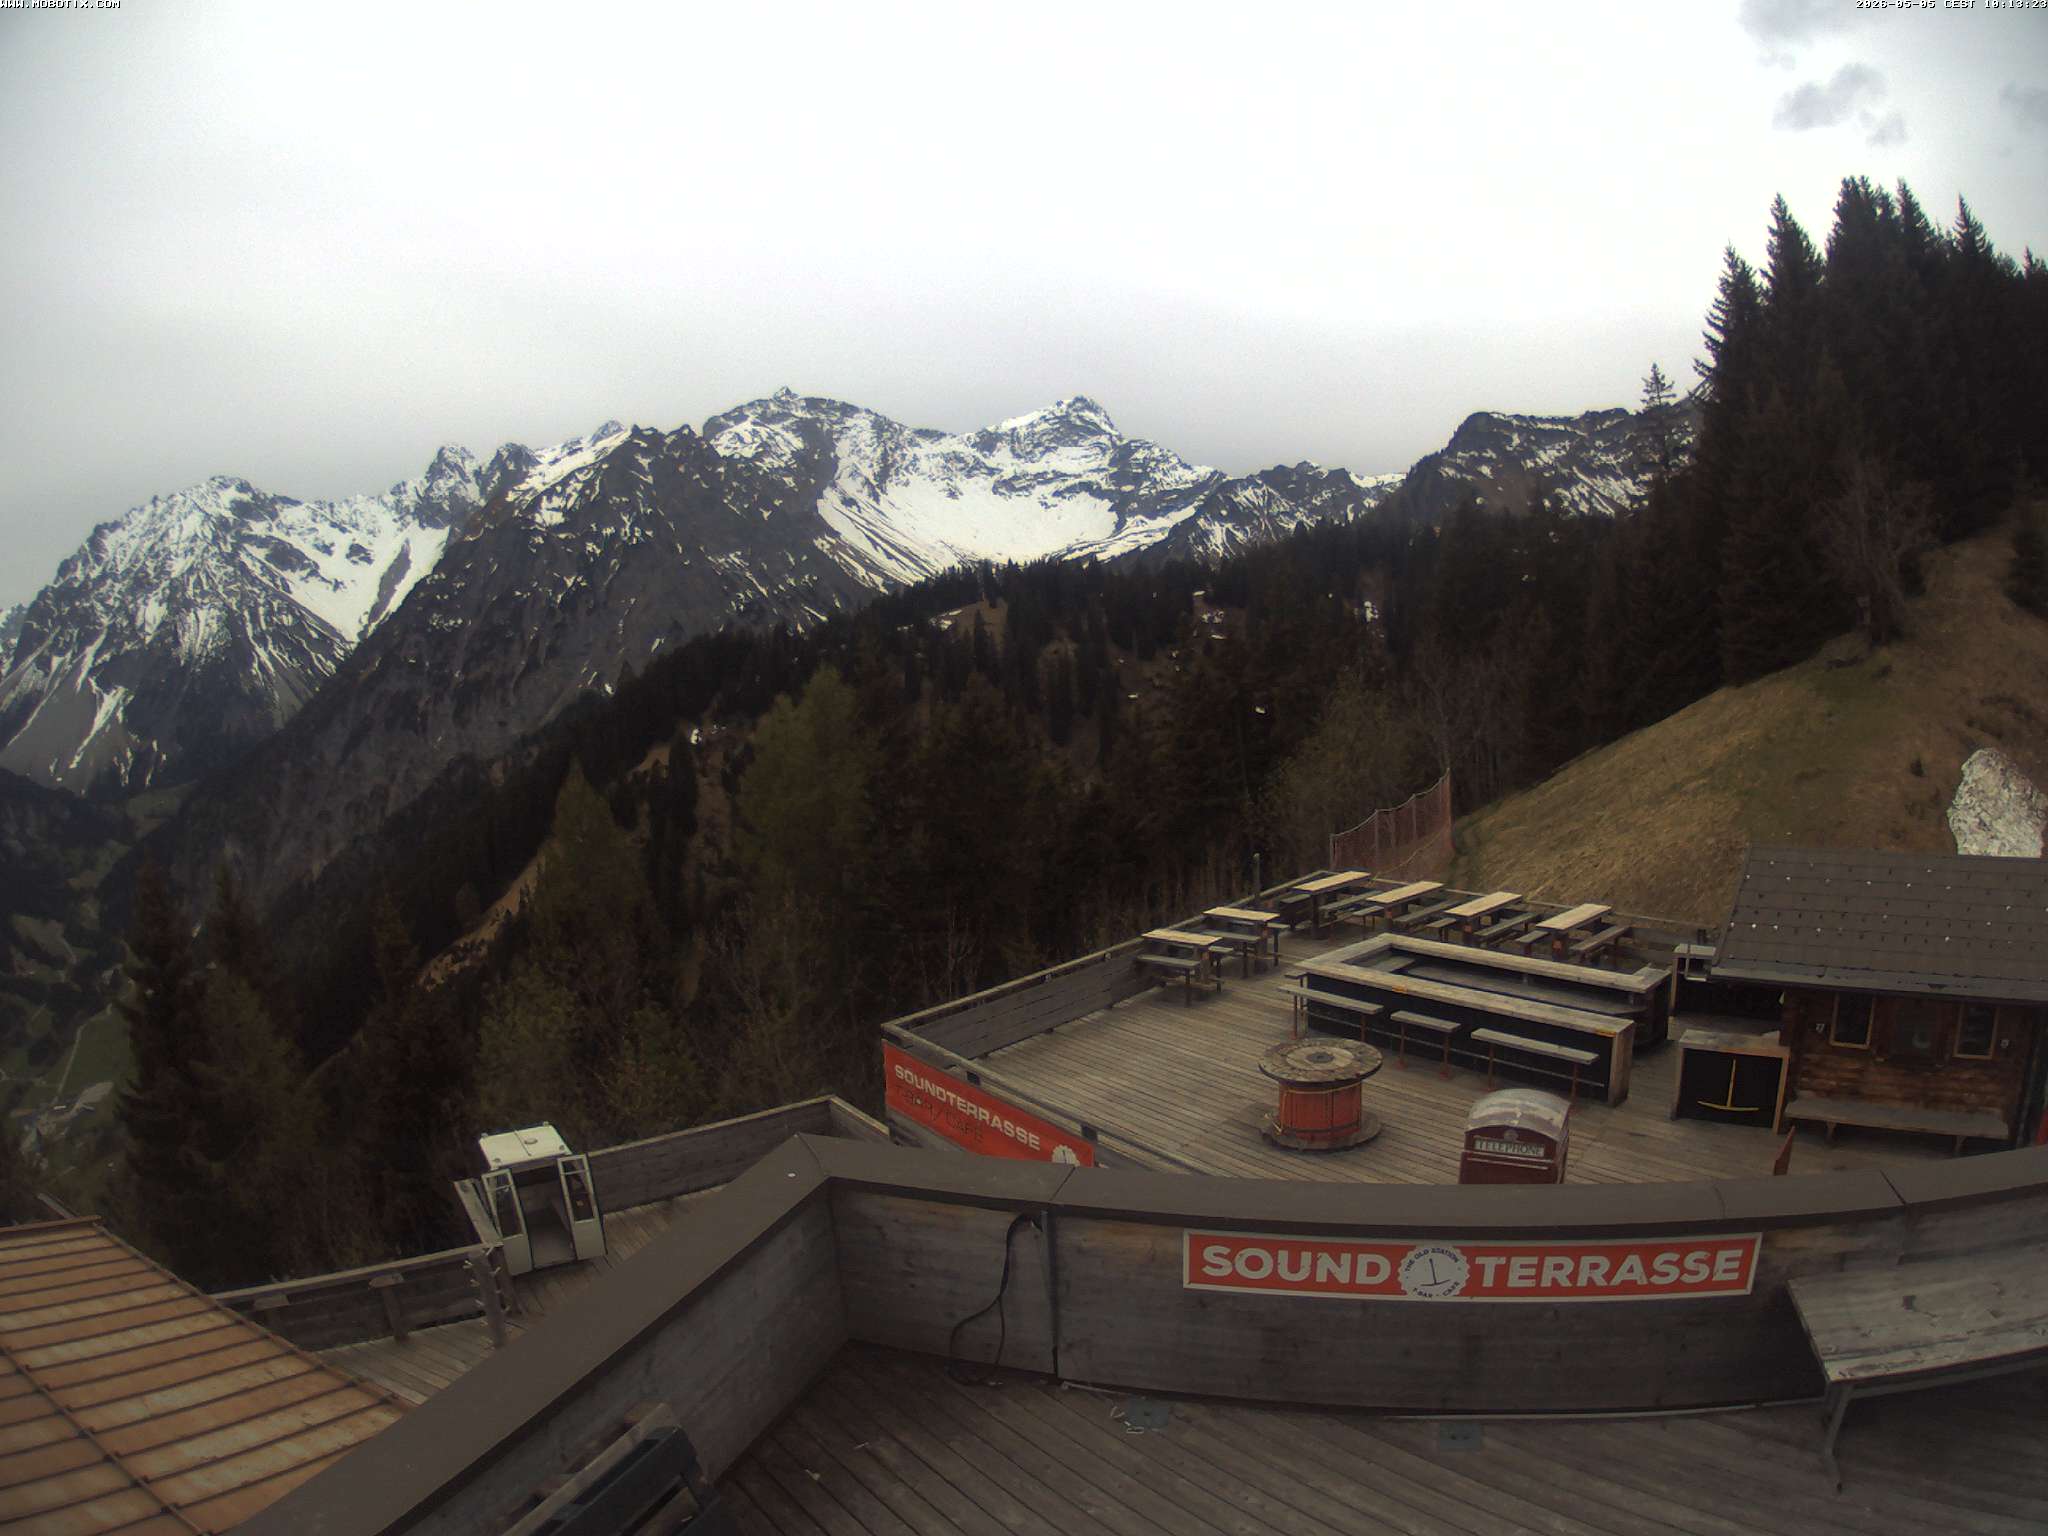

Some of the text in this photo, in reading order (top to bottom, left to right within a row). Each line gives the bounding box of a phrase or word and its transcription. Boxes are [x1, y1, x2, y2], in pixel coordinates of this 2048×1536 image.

[894, 1064, 1041, 1151] SOUNDTERRASSE
[1476, 1141, 1543, 1156] TELEPHONE
[1202, 1244, 1389, 1286] SOUND
[1414, 1248, 1430, 1259] OLD
[1475, 1248, 1744, 1288] TERRASSE
